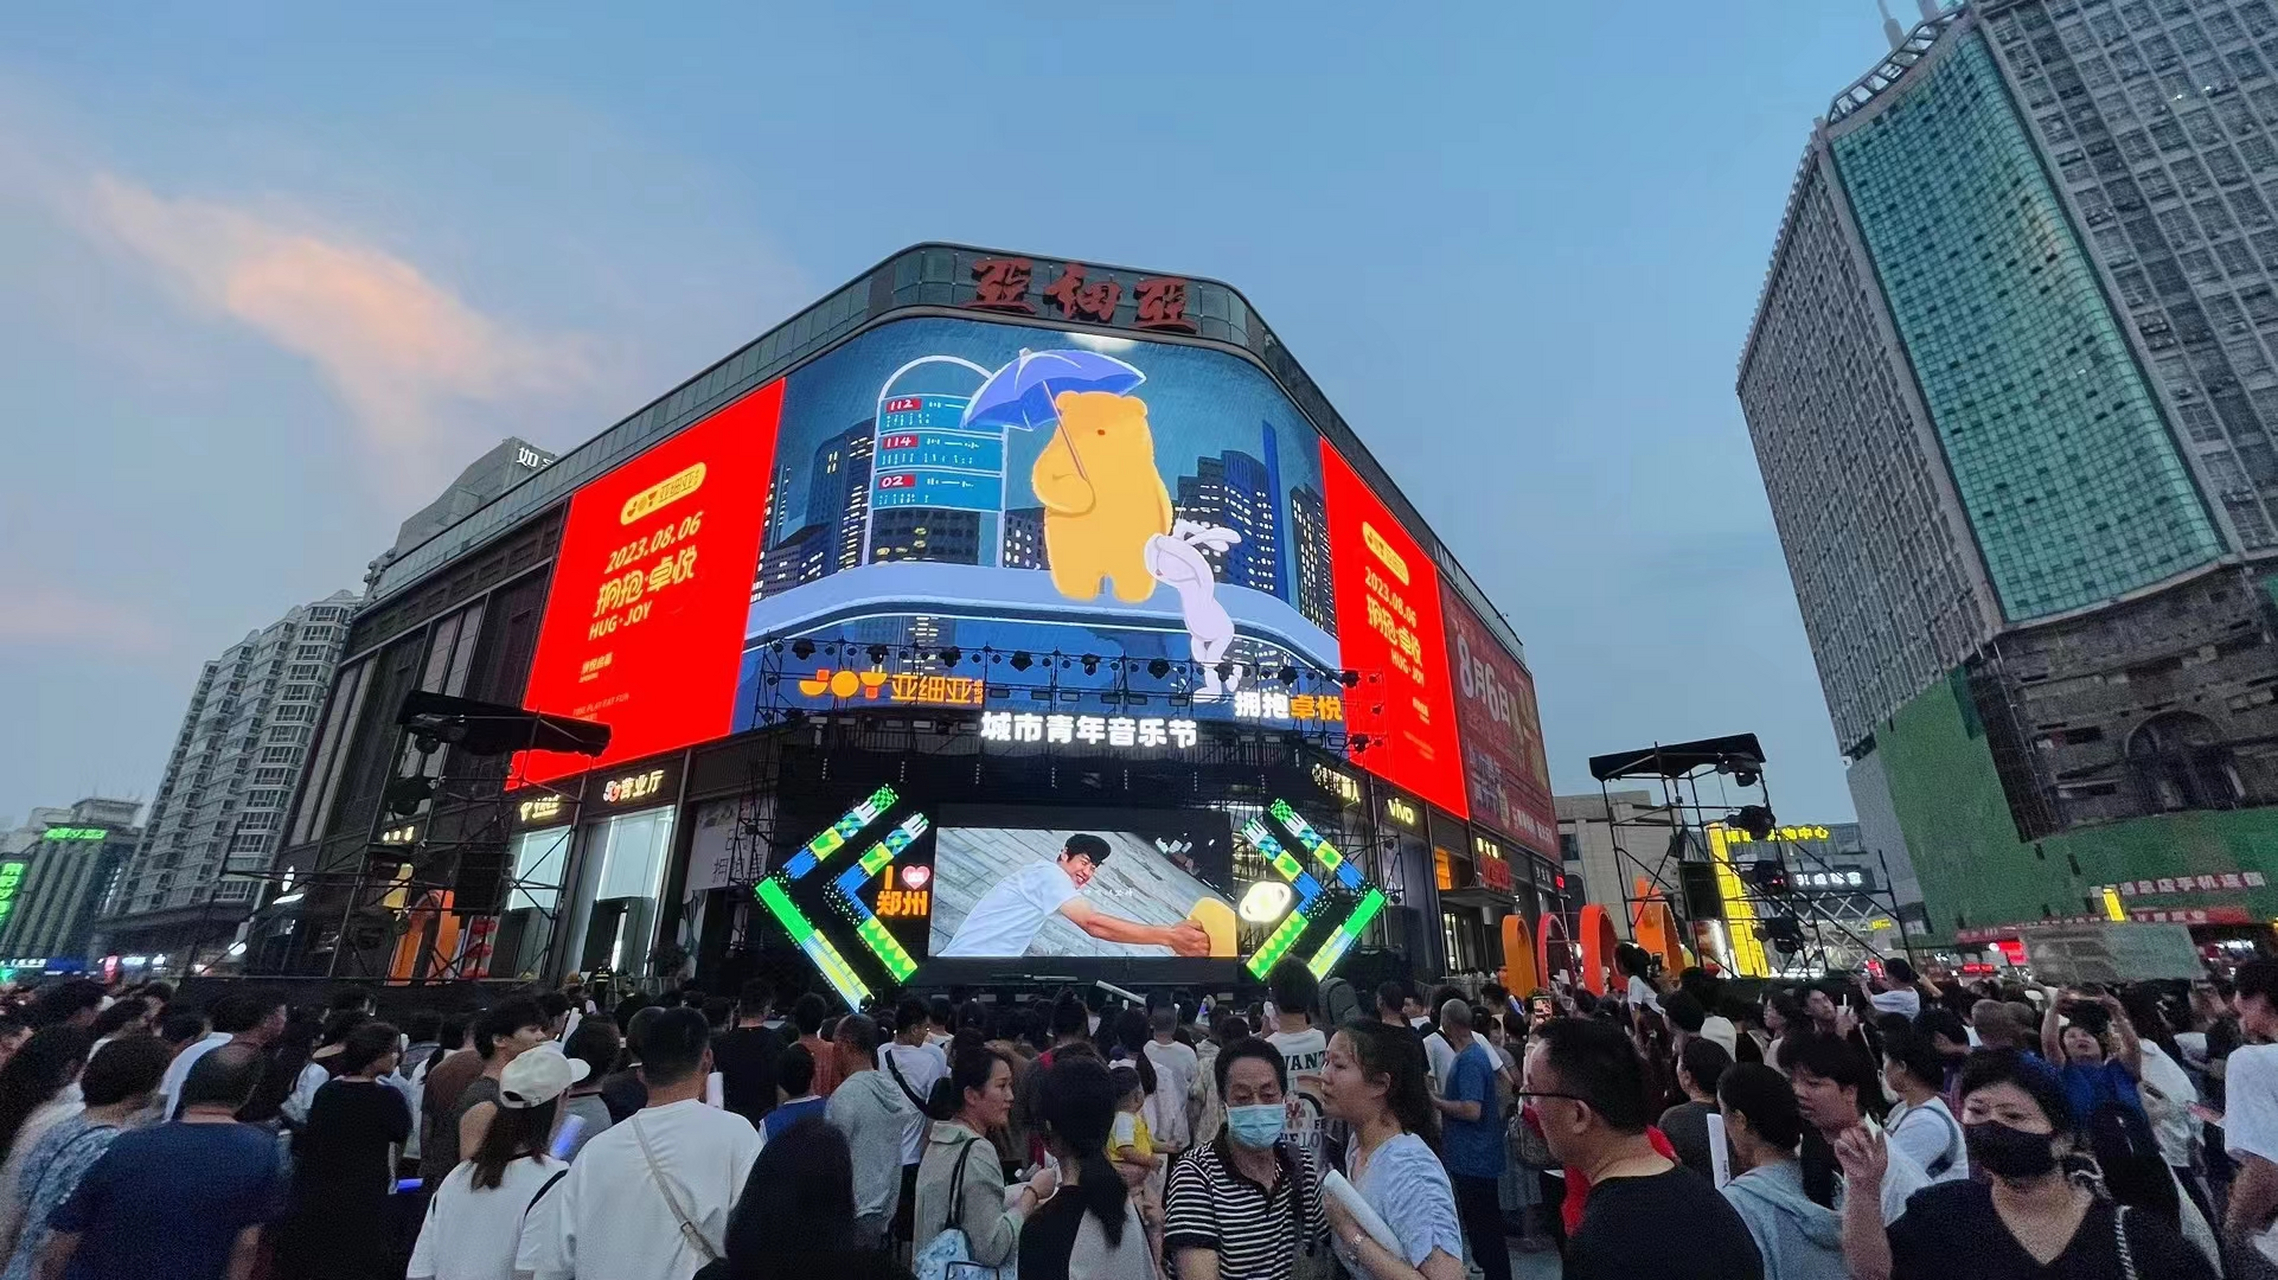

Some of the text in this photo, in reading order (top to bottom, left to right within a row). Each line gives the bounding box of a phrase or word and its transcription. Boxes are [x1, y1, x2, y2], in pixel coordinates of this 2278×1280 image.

[890, 399, 913, 410] 112
[886, 435, 912, 447] 114
[881, 476, 904, 488] 02
[604, 510, 704, 574] 2023.08.06
[1365, 566, 1417, 628] 2023.08.06
[890, 674, 972, 704] 亚细亚
[1457, 633, 1511, 727] 8月6日
[1234, 690, 1343, 721] 拥抱卓悦
[981, 712, 1197, 748] 城市青年音乐节
[603, 770, 664, 802] 5G营业厅
[1387, 797, 1415, 826] vivo
[884, 865, 894, 890] I
[876, 891, 928, 916] 郑州
